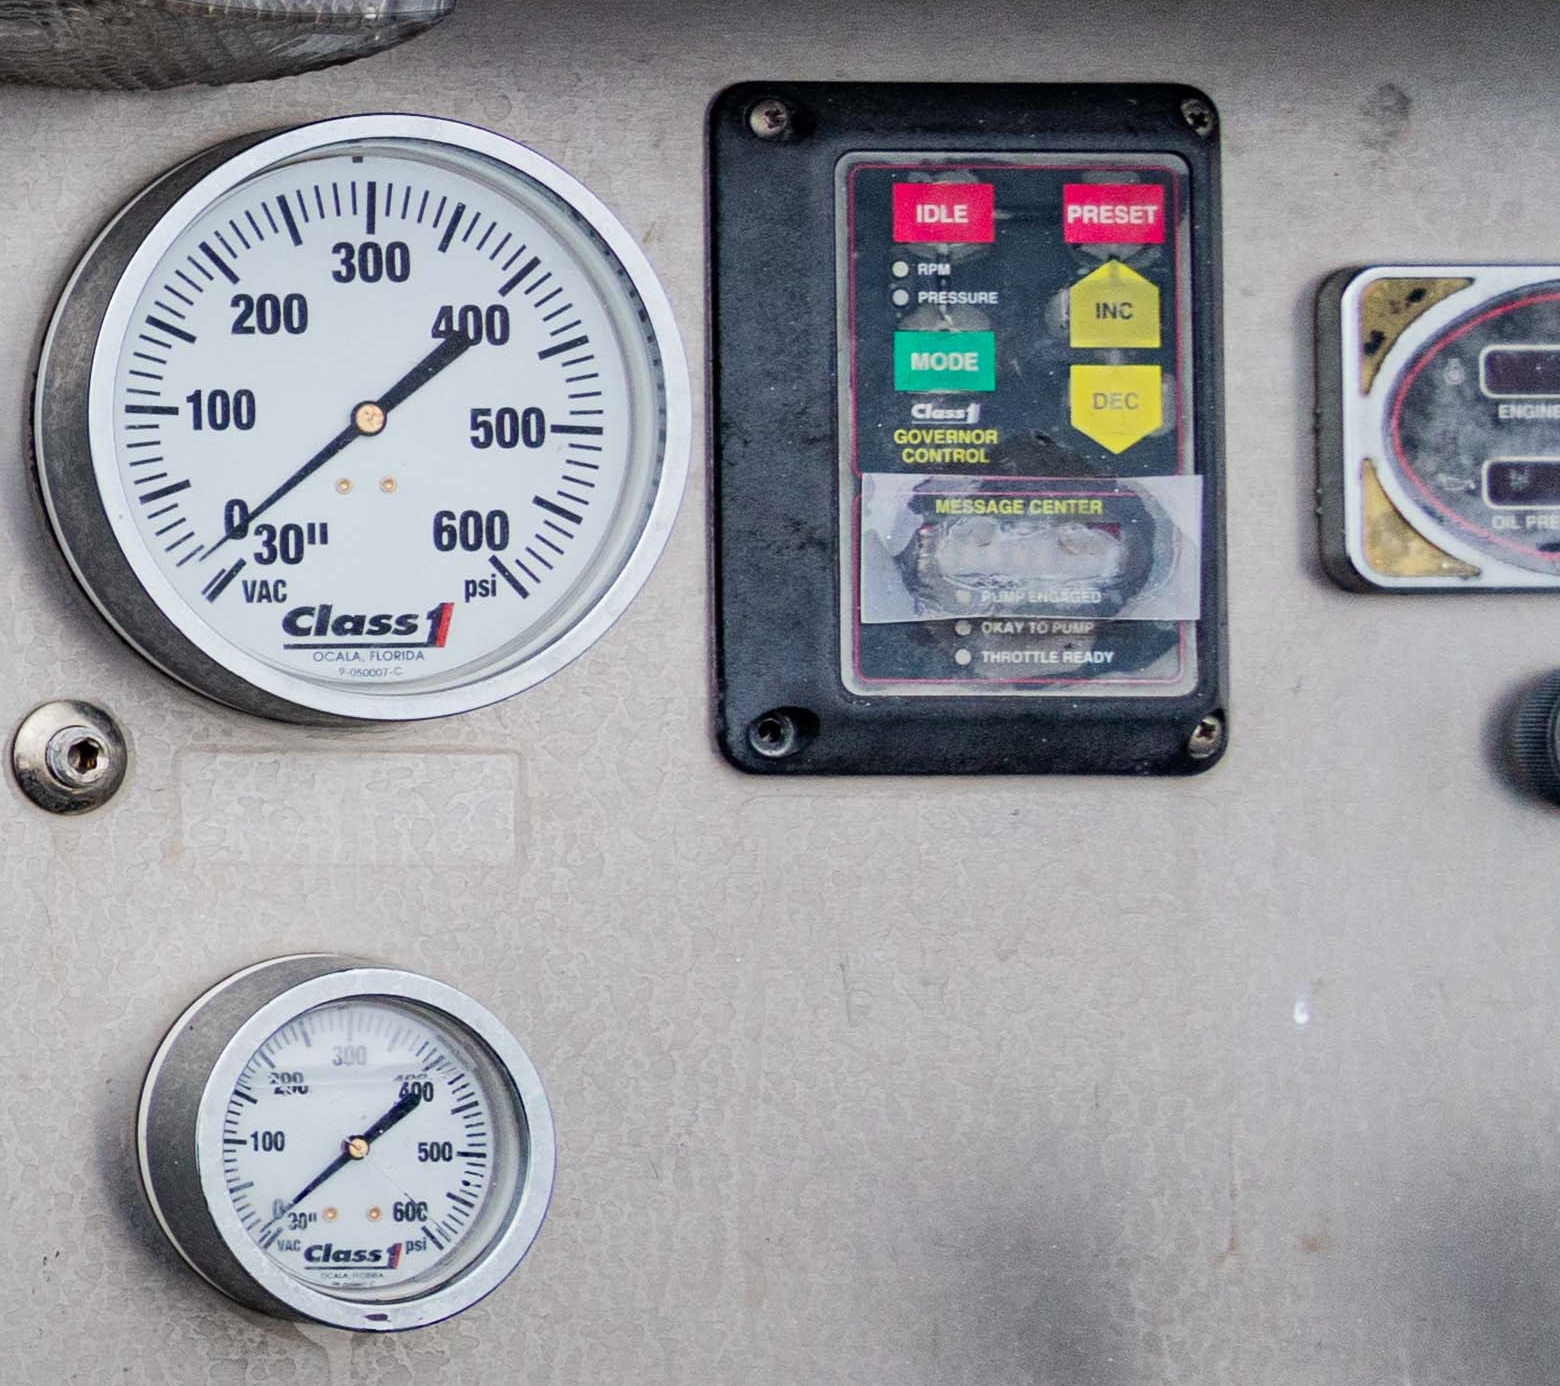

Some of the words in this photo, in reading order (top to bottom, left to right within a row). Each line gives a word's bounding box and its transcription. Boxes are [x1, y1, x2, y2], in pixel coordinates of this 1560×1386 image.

[916, 204, 968, 224] IDLE
[1067, 205, 1158, 225] PRESET
[332, 242, 411, 283] 300
[918, 264, 951, 275] RPM
[918, 291, 998, 304] PRESSURE
[231, 294, 309, 335] 200
[1095, 301, 1134, 319] INC
[432, 305, 510, 346] 400
[910, 352, 979, 371] MODE
[186, 389, 256, 430] 100
[1092, 392, 1139, 411] DEC
[1498, 404, 1560, 419] ENGINE
[470, 407, 546, 449] 500
[894, 429, 999, 444] GOVERNOR
[902, 448, 990, 463] CONTROL
[935, 499, 1024, 514] MESSAGE
[1029, 499, 1103, 514] CENTER
[224, 499, 249, 540] 0
[1491, 515, 1522, 529] OIL
[433, 510, 510, 552] 600
[243, 580, 287, 604] VAC
[464, 575, 497, 603] psi
[1029, 591, 1102, 603] ENGAGED
[981, 622, 1024, 634] OKAY
[1029, 622, 1049, 634] TO
[1052, 621, 1096, 633] PUMP
[313, 651, 365, 663] OCALA,
[370, 650, 425, 661] FLORIDA
[981, 651, 1058, 663] THROTTLE
[1063, 651, 1115, 663] READY
[331, 1045, 368, 1067] 300
[249, 1130, 286, 1152] 100
[417, 1141, 453, 1163] 500
[393, 1201, 428, 1222] 600
[276, 1239, 301, 1253] VAC
[405, 1237, 428, 1255] psi
